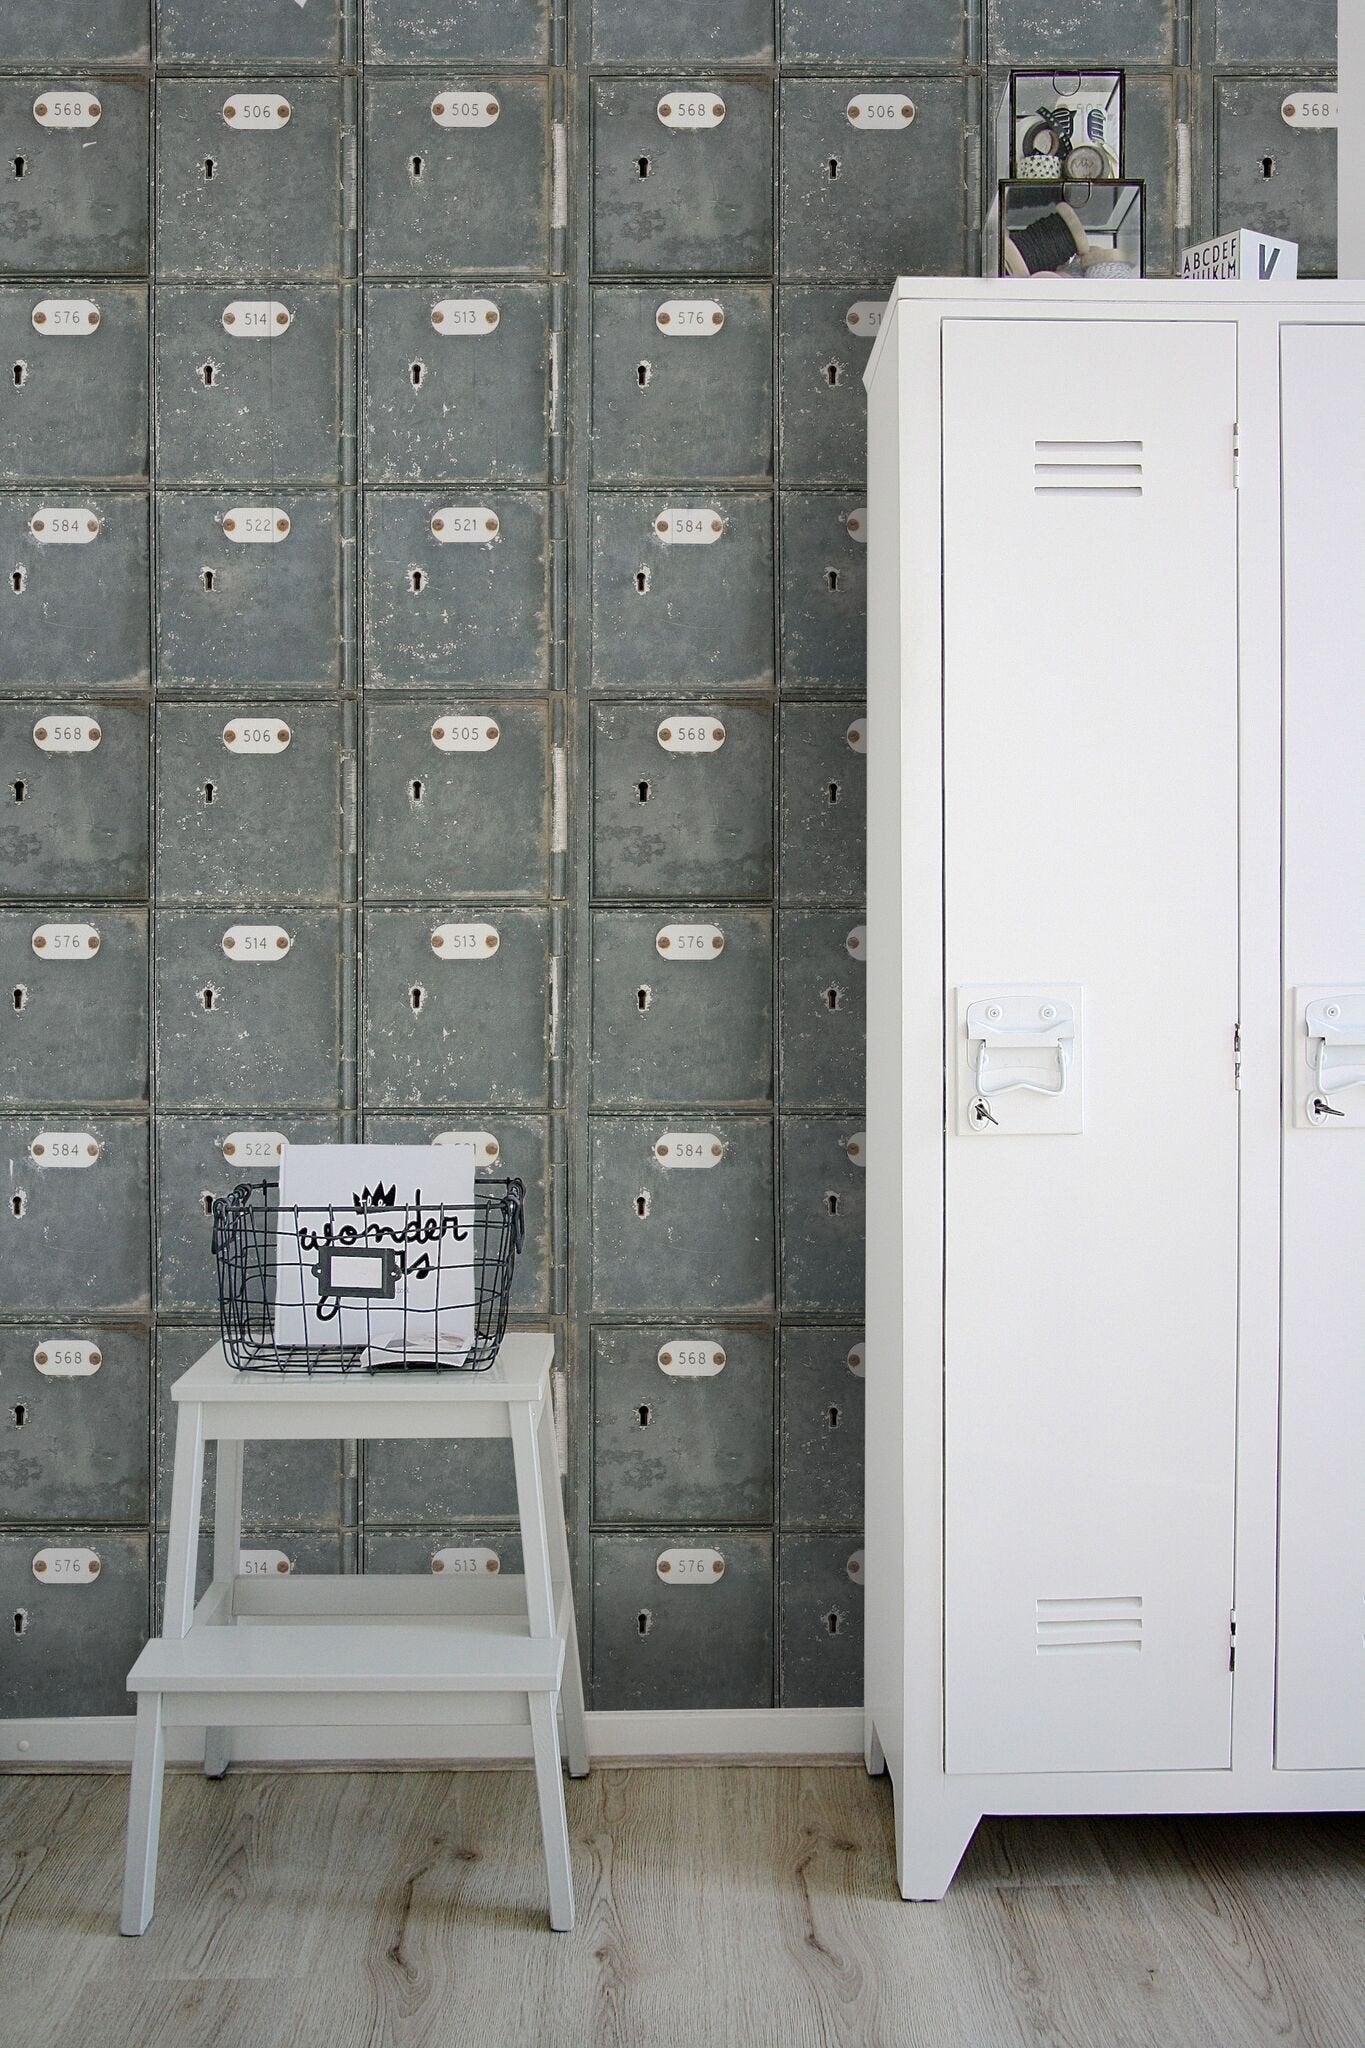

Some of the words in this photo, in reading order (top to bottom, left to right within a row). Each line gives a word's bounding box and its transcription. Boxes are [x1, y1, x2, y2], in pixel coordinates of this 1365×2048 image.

[54, 103, 82, 116] 568
[243, 105, 271, 119] 506
[452, 103, 479, 117] 505
[678, 103, 706, 117] 568
[867, 105, 895, 119] 506
[1301, 103, 1329, 117] 568
[1183, 238, 1237, 274] ABCDEF
[1259, 243, 1281, 280] V
[54, 310, 81, 324] 576
[244, 312, 268, 326] 514
[454, 310, 477, 324] 513
[678, 311, 705, 325] 576
[869, 312, 882, 326] 51
[52, 519, 79, 533] 584
[245, 518, 271, 532] 522
[454, 518, 477, 532] 521
[676, 519, 703, 533] 584
[54, 727, 82, 741] 568
[243, 729, 271, 743] 506
[452, 727, 479, 741] 505
[678, 727, 706, 741] 568
[54, 935, 81, 949] 576
[244, 936, 268, 950] 514
[454, 934, 477, 948] 513
[678, 935, 705, 949] 576
[52, 1143, 79, 1157] 584
[245, 1143, 271, 1157] 522
[676, 1143, 703, 1157] 584
[300, 1188, 468, 1250] wonder
[54, 1351, 82, 1365] 568
[679, 1351, 706, 1365] 568
[54, 1559, 81, 1573] 576
[245, 1560, 268, 1574] 514
[454, 1559, 477, 1573] 513
[678, 1559, 705, 1573] 576
